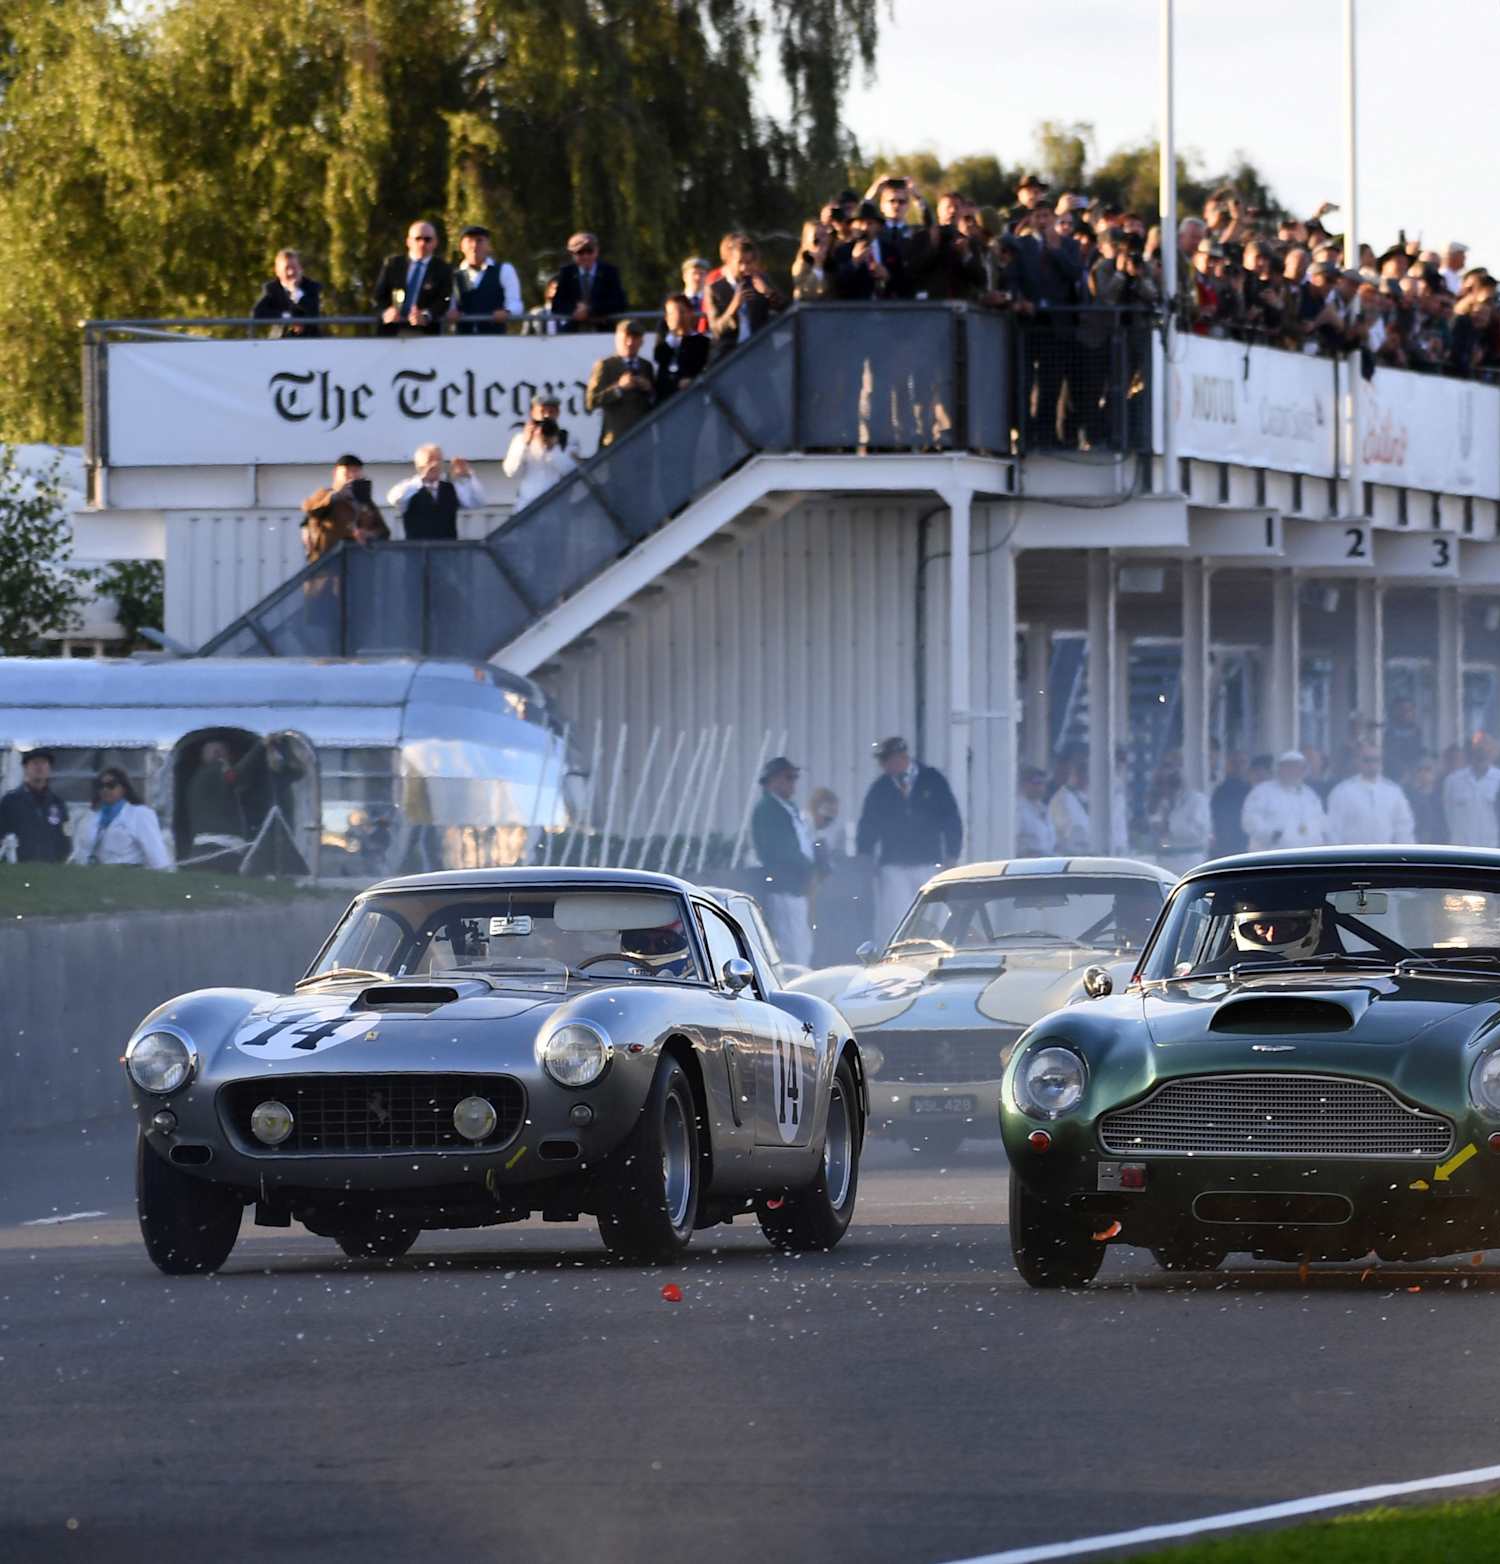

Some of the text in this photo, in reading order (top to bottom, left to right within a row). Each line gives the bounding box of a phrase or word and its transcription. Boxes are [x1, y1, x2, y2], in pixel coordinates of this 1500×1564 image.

[269, 369, 374, 432] The
[1265, 516, 1274, 548] 1
[1345, 527, 1366, 558] 2
[1431, 538, 1450, 568] 3
[242, 1009, 367, 1050] 14
[775, 1024, 799, 1125] 14
